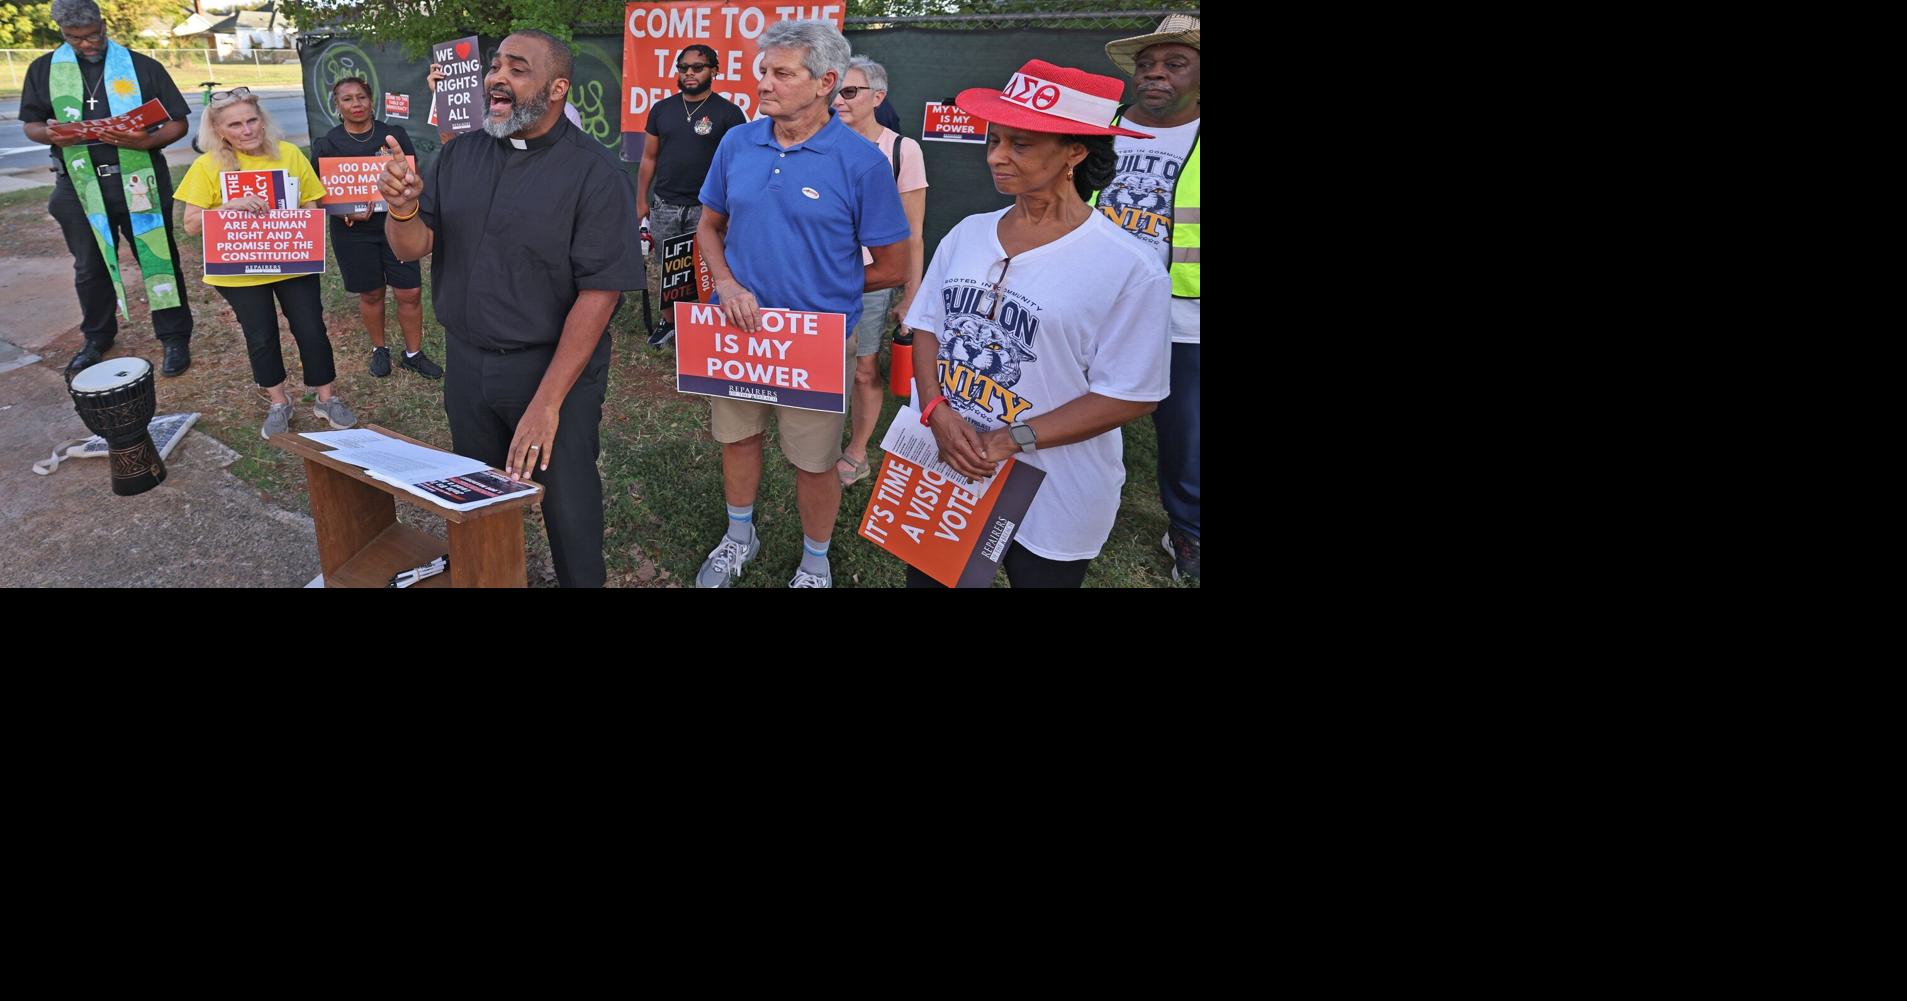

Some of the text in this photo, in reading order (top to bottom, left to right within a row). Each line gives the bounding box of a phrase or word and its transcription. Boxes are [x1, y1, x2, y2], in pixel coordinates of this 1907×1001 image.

[629, 7, 712, 39] COME
[721, 7, 765, 39] TO
[436, 48, 454, 62] WE
[437, 75, 478, 93] RIGHTS
[448, 92, 471, 106] FOR
[448, 107, 470, 121] ALL
[932, 105, 949, 114] MY
[940, 115, 970, 124] IS MY
[936, 124, 975, 134] POWER
[337, 163, 387, 173] 100 DAY
[1115, 155, 1179, 180] UILT O
[227, 174, 240, 194] THE
[321, 174, 355, 185] 1,000
[327, 186, 344, 196] TO
[347, 185, 368, 195] THE
[269, 210, 312, 218] RIGHTS
[223, 221, 307, 230] ARE A HUMAN
[1098, 205, 1171, 244] NIT
[227, 231, 304, 240] RIGHT AND A
[216, 241, 313, 251] PROMISE OF THE
[665, 240, 694, 259] LIFT
[221, 251, 310, 261] CONSTITUTION
[665, 255, 692, 273] VOIC
[663, 270, 691, 289] LIFT
[701, 275, 710, 292] 100
[663, 284, 694, 303] VOTE
[690, 305, 818, 336] MY OTE
[943, 287, 1038, 346] BUIL ON
[715, 333, 793, 360] IS MY
[707, 357, 811, 389] POWER
[729, 385, 778, 397] REPAIRERS
[936, 360, 1033, 425] NITY
[864, 459, 913, 544] IT'S TIME
[906, 466, 948, 521] VISIO
[933, 484, 979, 542] VOTE
[900, 523, 926, 544] A
[981, 515, 1008, 558] REPAIRERS
